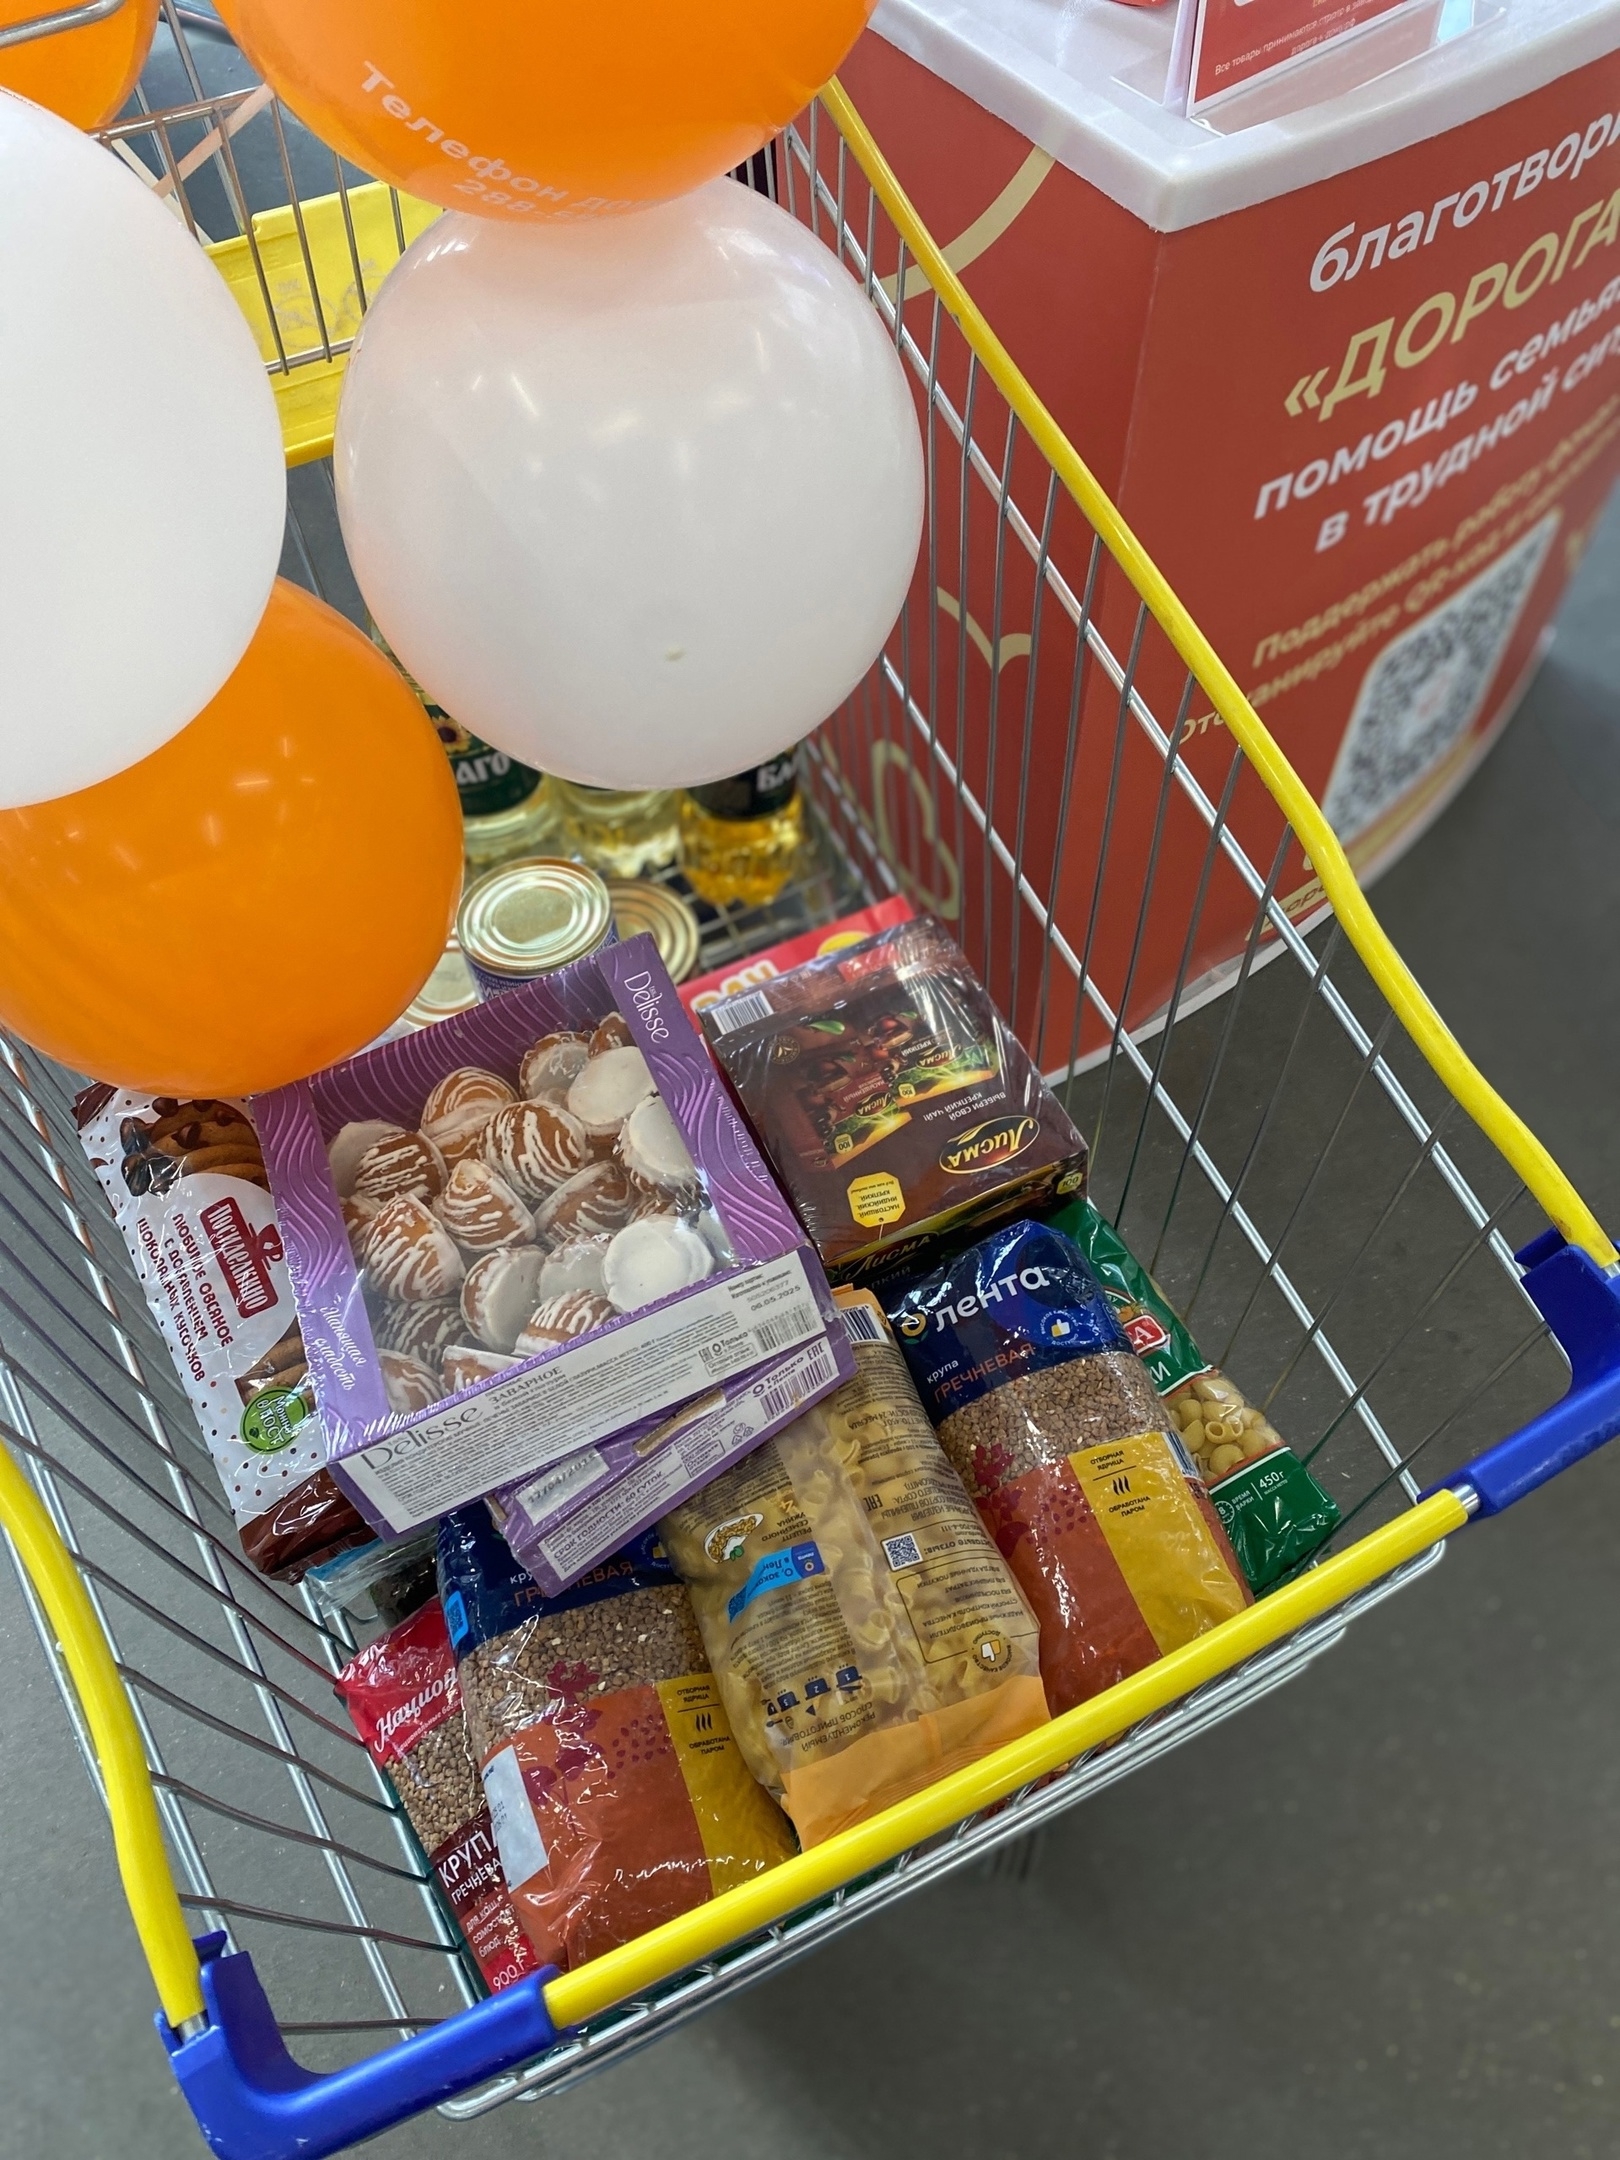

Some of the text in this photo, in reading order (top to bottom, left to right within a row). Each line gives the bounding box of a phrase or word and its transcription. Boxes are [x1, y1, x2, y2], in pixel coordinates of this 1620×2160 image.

[1215, 62, 1230, 76] Все
[1232, 49, 1262, 67] товары
[358, 60, 570, 202] Телефон
[1253, 380, 1479, 520] помощь
[1314, 510, 1350, 554] в
[1363, 366, 1560, 526] трудной
[922, 1091, 982, 1121] КРЕПКИЙ ЧАЙ!
[947, 1091, 1006, 1121] ВЫБЕРИ СВОЙ
[837, 1139, 851, 1150] 100
[749, 1284, 801, 1311] 06.05.2025
[931, 1262, 1050, 1332] лента
[199, 1281, 233, 1347] ОВСЯНОЕ
[720, 1330, 749, 1347] Только
[173, 1313, 205, 1382] КУСОЧКОВ
[764, 1355, 804, 1384] Только
[926, 1359, 959, 1383] крупа
[933, 1341, 1035, 1402] ГРЕЧНЕВАЯ
[487, 1365, 563, 1405] ЗАВАРНОЕ
[848, 1411, 886, 1429] 24 МЕСЯЦА
[1090, 1450, 1123, 1464] ОТБОРНАЯ
[1097, 1458, 1124, 1470] ЯДРИЦА
[1257, 1470, 1280, 1490] 450
[892, 1491, 917, 1504] СОРТА:
[918, 1495, 945, 1506] СОРТОВ
[1108, 1495, 1150, 1512] ОБРАБОТАНА
[1231, 1489, 1250, 1504] ВРЕМЯ
[1235, 1495, 1254, 1510] ВАРКИ
[880, 1501, 918, 1518] ПШЕНИЦЫ
[910, 1505, 943, 1521] ИЗДЕЛИЯ
[1121, 1504, 1144, 1516] ПАРОМ
[1217, 1506, 1226, 1515] 8
[552, 1538, 577, 1559] СРОК
[576, 1500, 625, 1541] ГОДНОСТИ:
[624, 1491, 636, 1503] 60
[776, 1511, 805, 1527] УЖИНА
[761, 1519, 808, 1541] СЕМЕЙНОГО
[781, 1526, 811, 1541] РЕЦЕПТ
[923, 1540, 955, 1555] отзыв:
[509, 1571, 534, 1585] кру
[916, 1573, 949, 1588] ПОКУПКИ
[956, 1602, 990, 1615] КОНТРОЛЬ
[921, 1611, 957, 1627] КАЧЕСТВА
[928, 1615, 988, 1638] ПРОИЗВОДИТЕЛИ
[970, 1627, 1001, 1644] ДОСТУПНО
[971, 1649, 998, 1676] КАЧЕСТВО
[676, 1684, 710, 1695] ОТБОРНАЯ
[683, 1693, 709, 1702] ЯДРИЦА
[813, 1685, 819, 1693] 2
[372, 1665, 462, 1753] Национ
[838, 1700, 873, 1722] СПОСОБ
[800, 1711, 876, 1752] РЕКОМЕНДУЕМЫЙ
[688, 1736, 730, 1748] ОБРАБОТАНА
[700, 1745, 724, 1754] ПАРОМ
[450, 1855, 503, 1904] ГРЕЧНЕВА
[465, 1914, 480, 1932] для
[491, 1963, 519, 1990] 900
